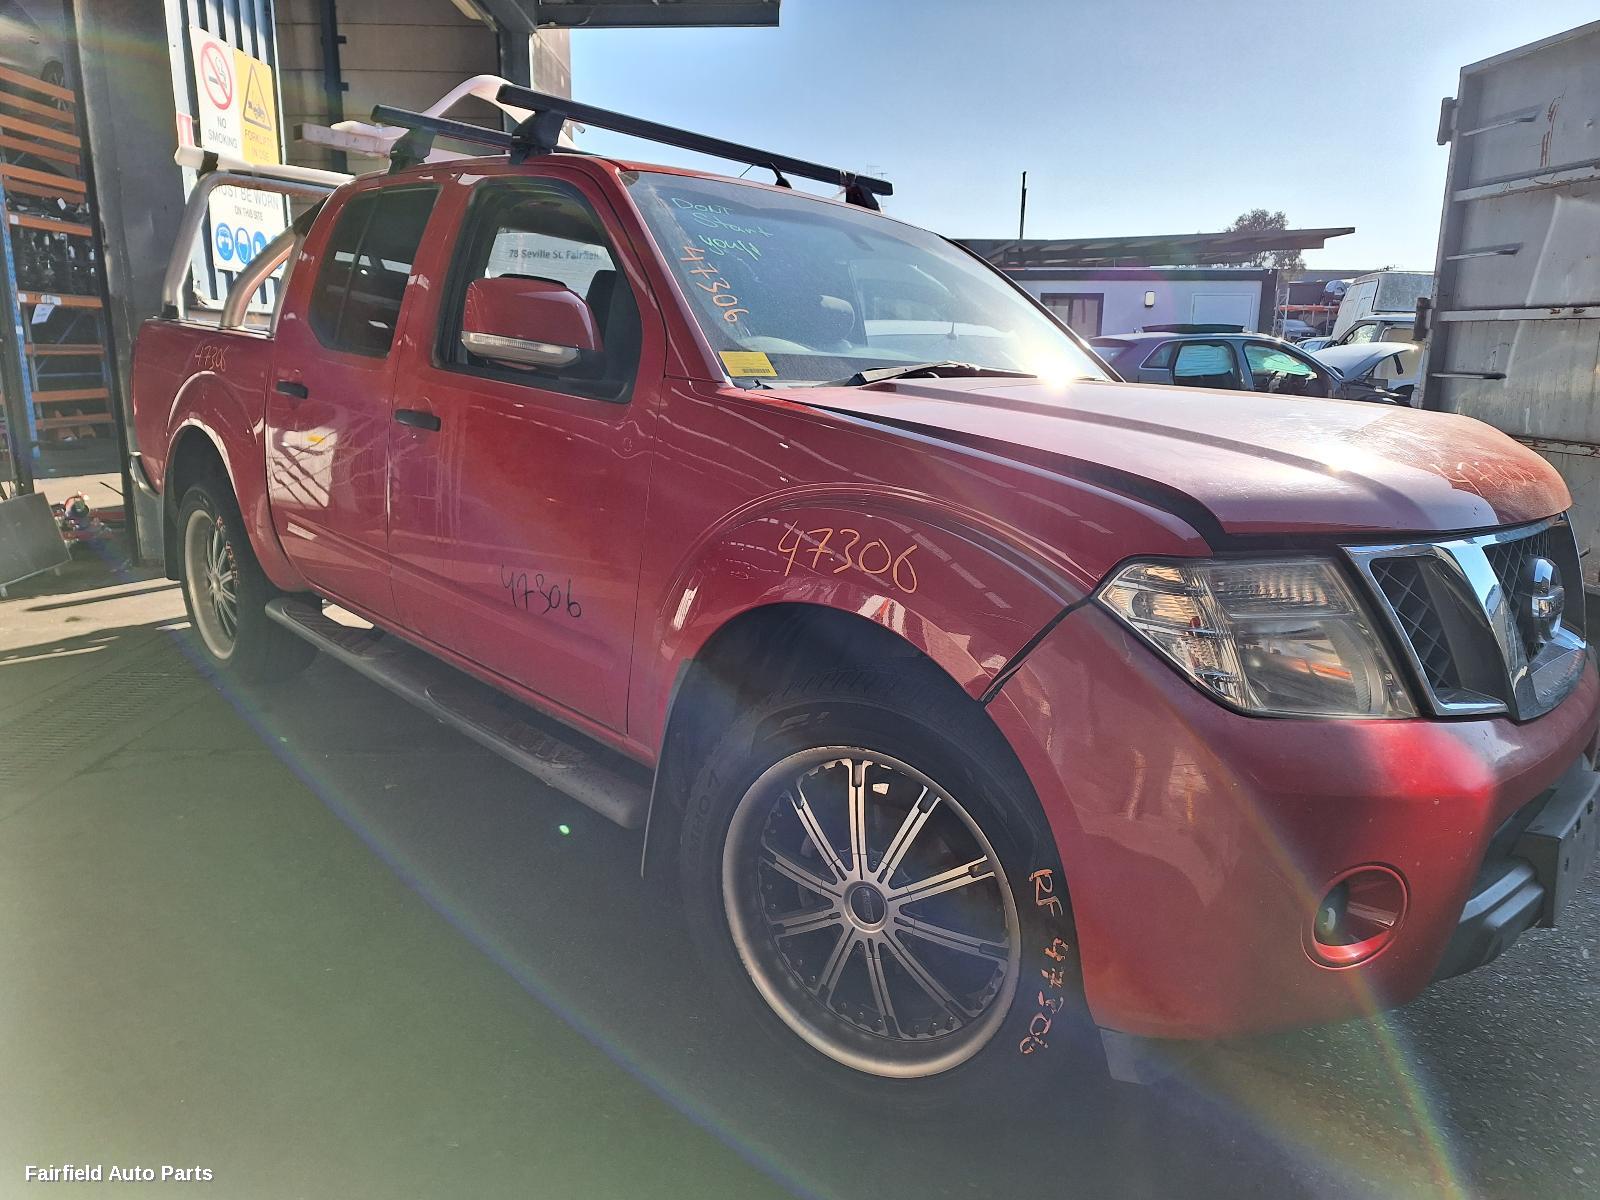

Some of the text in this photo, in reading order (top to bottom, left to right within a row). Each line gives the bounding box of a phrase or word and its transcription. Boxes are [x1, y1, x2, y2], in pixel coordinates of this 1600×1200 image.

[217, 115, 227, 129] NO
[208, 128, 238, 149] SMOKING
[240, 188, 252, 203] BE
[253, 191, 280, 210] WORN
[242, 207, 254, 219] THIS
[254, 210, 264, 221] SITE
[521, 248, 551, 260] Seville
[680, 245, 750, 323] 47306
[194, 341, 230, 372] 47306
[777, 520, 918, 594] 47306
[501, 559, 582, 618] 47306
[1028, 868, 1064, 918] RF
